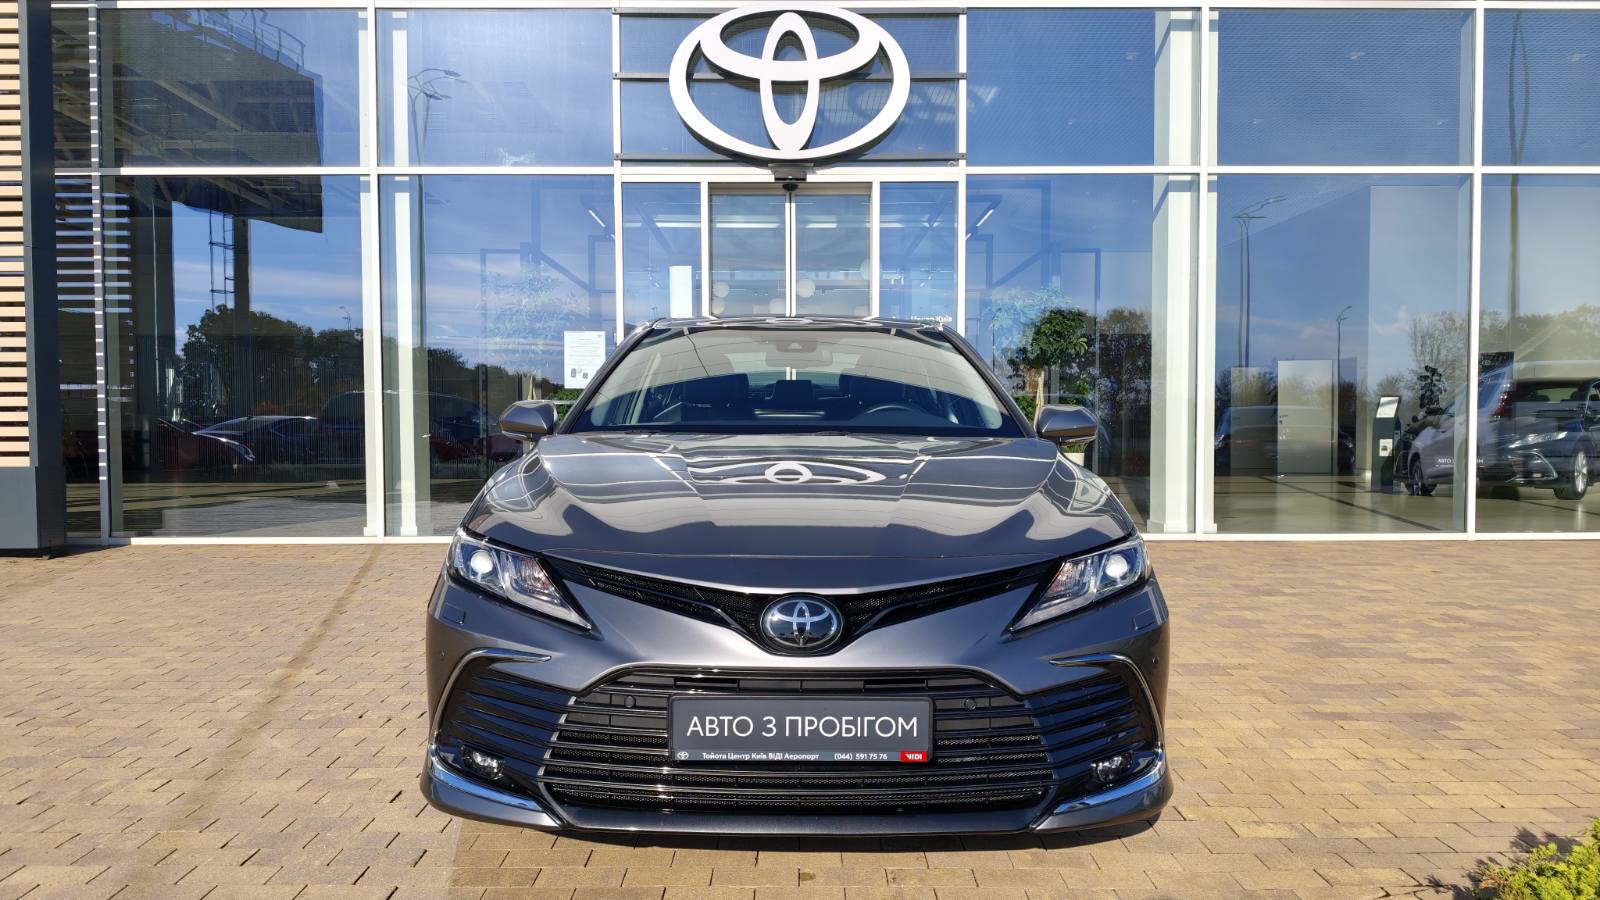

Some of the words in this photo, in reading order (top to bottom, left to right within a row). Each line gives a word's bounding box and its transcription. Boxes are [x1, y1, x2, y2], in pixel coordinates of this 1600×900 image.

[686, 715, 754, 738] АВТО
[761, 715, 777, 738] З
[785, 715, 918, 738] ПРОБІГОМ
[702, 752, 727, 760] Тойота
[727, 752, 751, 761] Центр
[751, 752, 767, 760] Київ
[768, 752, 783, 761] ВІДІ
[784, 752, 820, 761] Аеропорт
[834, 753, 853, 761] (044)
[855, 753, 868, 761] 591
[868, 753, 878, 761] 75
[879, 753, 888, 761] 76
[905, 753, 923, 761] VIDI
